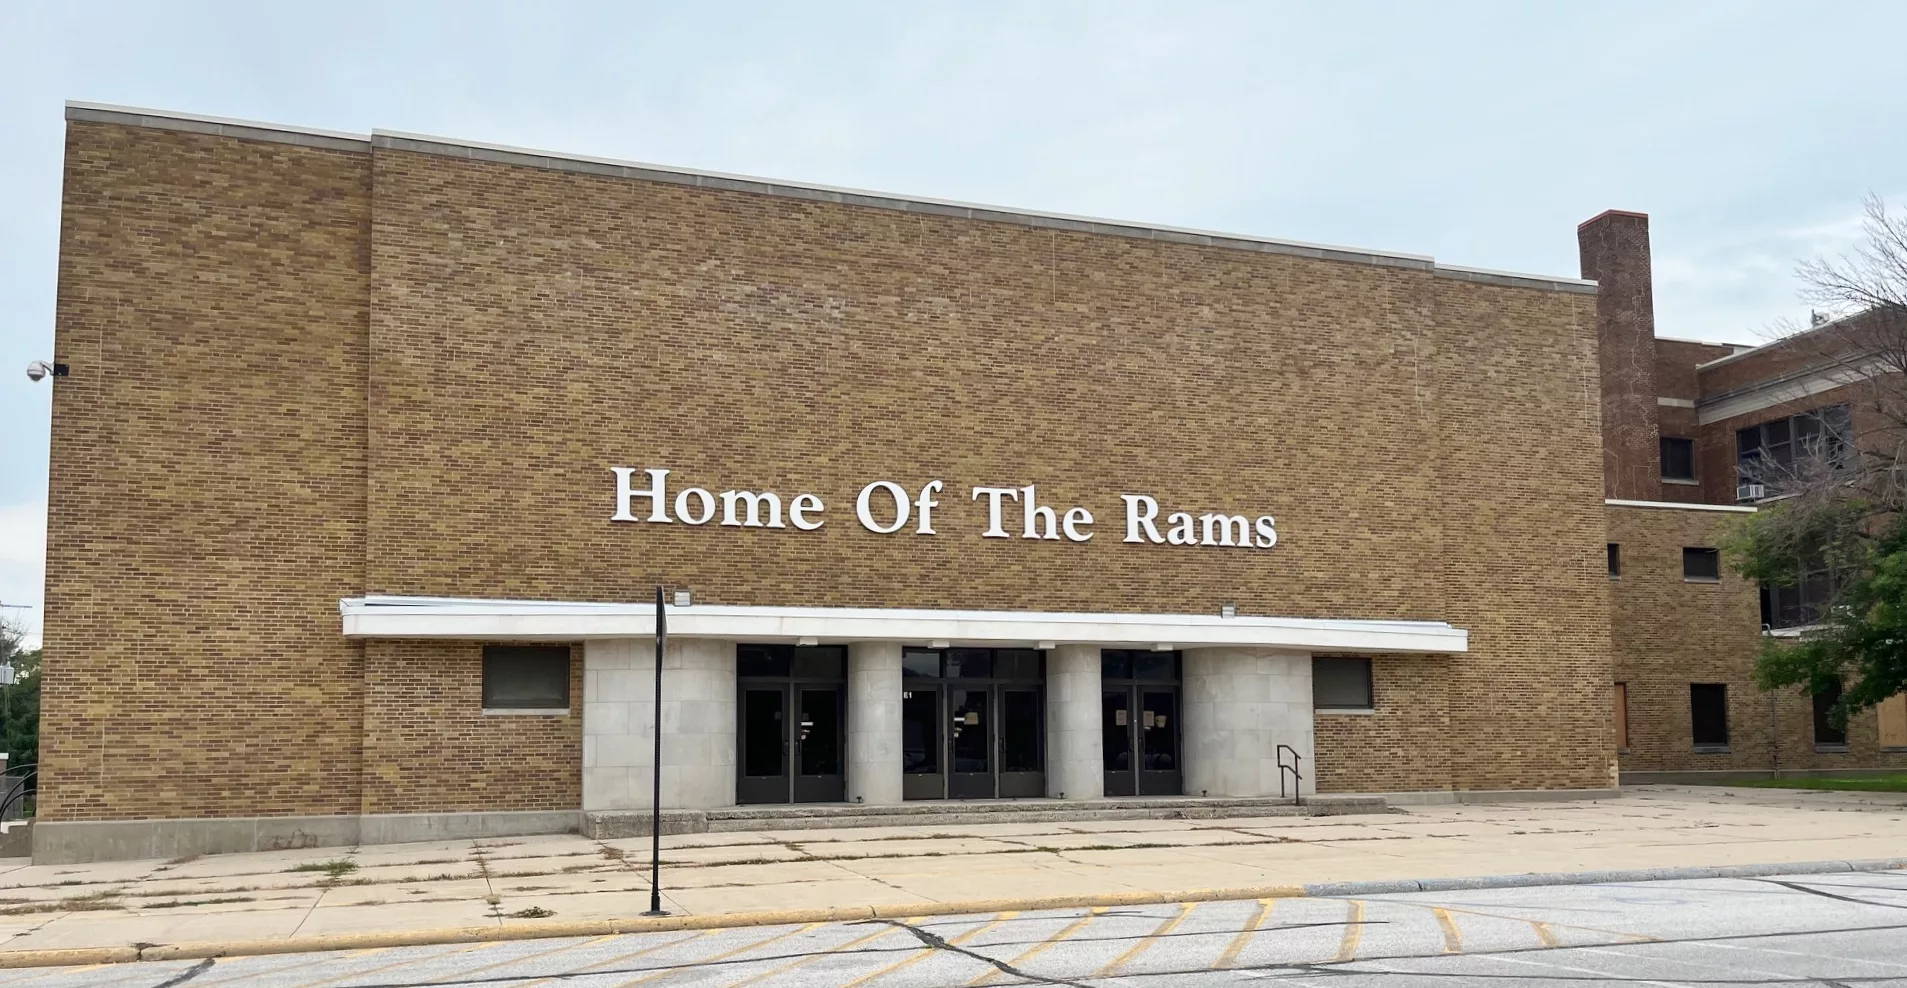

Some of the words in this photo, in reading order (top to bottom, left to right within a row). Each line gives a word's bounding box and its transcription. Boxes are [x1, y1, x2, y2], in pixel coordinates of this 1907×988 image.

[610, 466, 825, 530] Home
[856, 480, 943, 535] Of
[972, 484, 1094, 543] The
[1120, 494, 1278, 549] Rams
